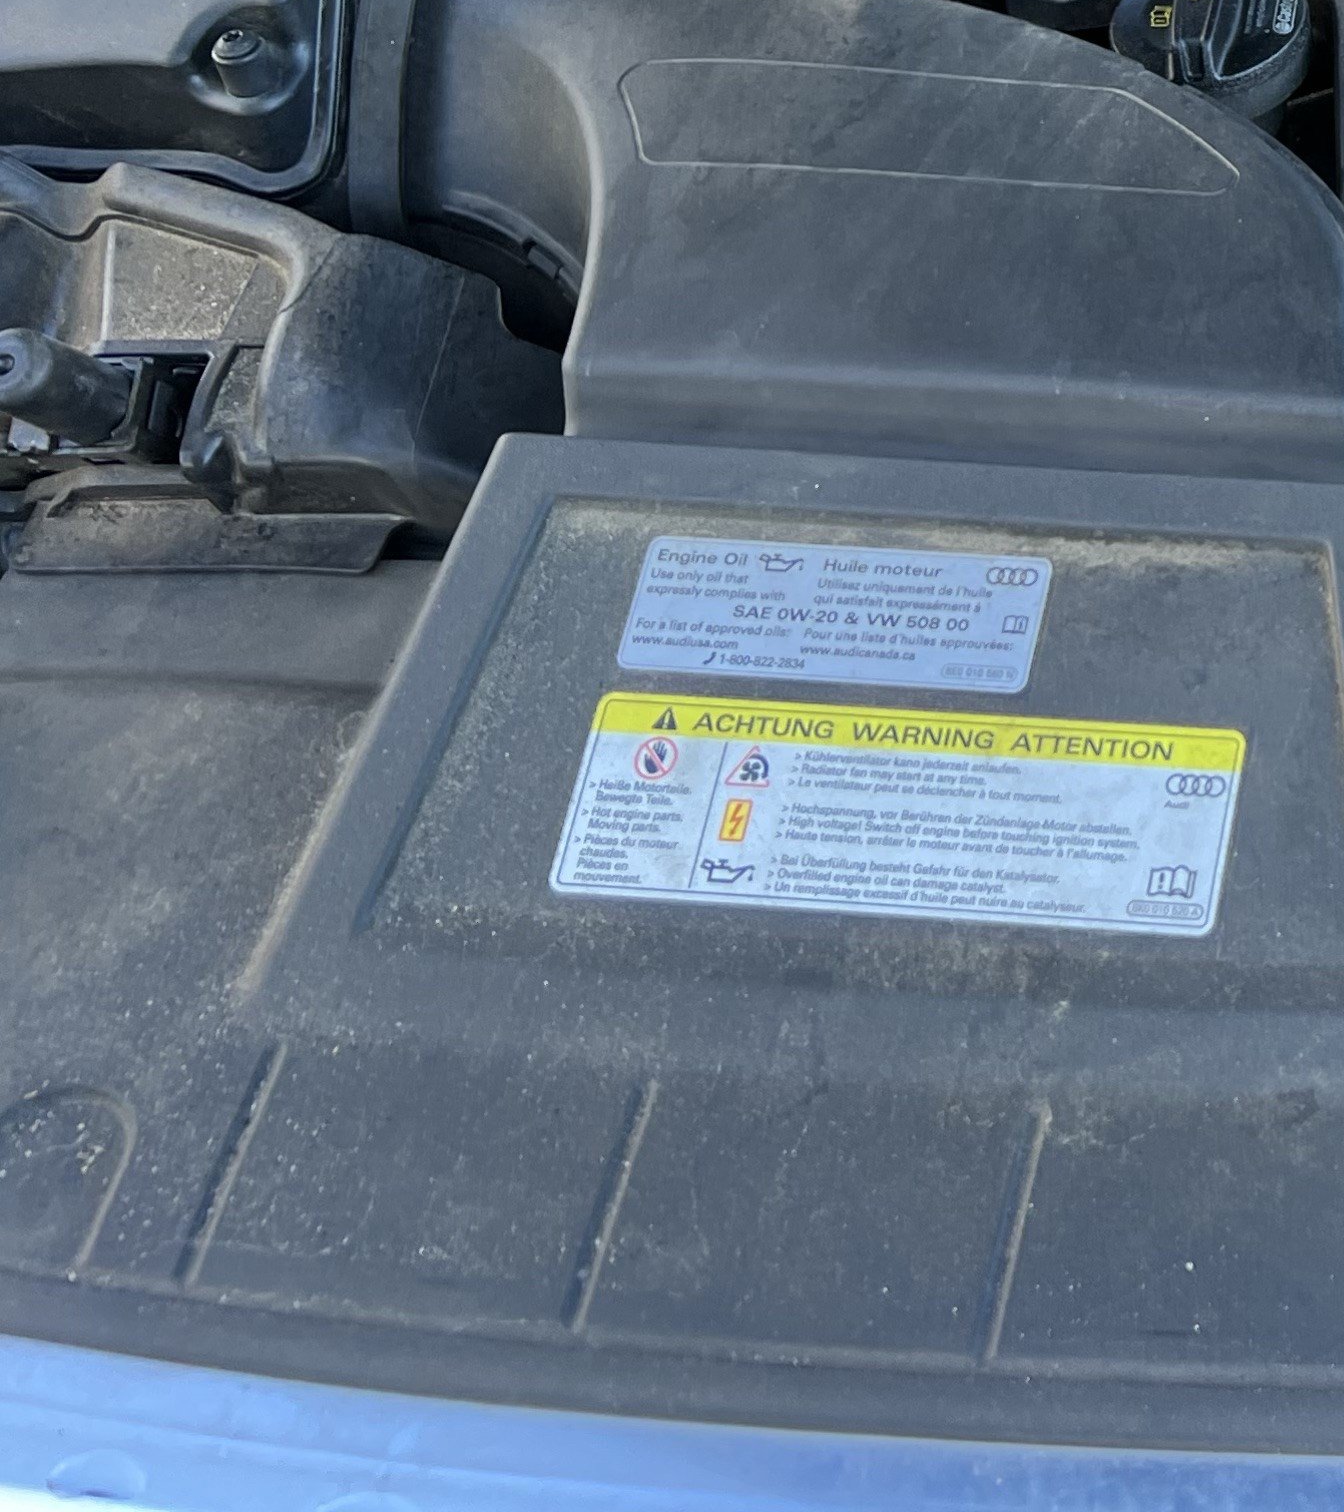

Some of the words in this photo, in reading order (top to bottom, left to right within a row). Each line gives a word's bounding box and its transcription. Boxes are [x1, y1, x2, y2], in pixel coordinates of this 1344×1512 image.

[658, 549, 717, 565] Engine
[724, 552, 748, 566] Oil
[823, 559, 868, 573] Huile
[874, 565, 942, 577] moteur
[651, 568, 674, 580] Use
[677, 570, 702, 584] only
[706, 571, 722, 582] oil
[725, 573, 749, 584] that
[647, 586, 701, 598] expressly
[705, 589, 757, 600] complies
[760, 592, 785, 601] with
[864, 583, 935, 595] uniquement
[938, 585, 953, 596] de
[813, 595, 833, 605] qui
[836, 596, 883, 607] satisfait
[733, 605, 772, 619] SAE
[778, 608, 838, 623] 0W-20
[867, 613, 901, 627] VW
[907, 616, 940, 630] 508
[946, 618, 970, 632] 00
[635, 617, 656, 629] For
[670, 620, 687, 631] list
[690, 621, 704, 632] of
[706, 625, 763, 636] approved
[633, 636, 738, 649] www.audiusa.com
[804, 628, 832, 640] Pour
[835, 633, 857, 642] une
[861, 632, 886, 644] liste
[801, 647, 915, 661] www.audicanada.ca
[695, 714, 833, 739] ACHTUNG
[854, 724, 993, 749] WARNING
[1012, 734, 1172, 759] ATTENTION
[802, 763, 847, 776] Radiator
[850, 767, 868, 778] fan
[870, 770, 894, 781] may
[923, 773, 935, 782] at
[936, 775, 957, 785] any
[797, 776, 812, 787] Le
[901, 786, 914, 794] se
[591, 807, 611, 817] Hot
[613, 810, 650, 821] engine
[880, 811, 898, 820] vor
[954, 813, 973, 825] der
[588, 818, 630, 833] Moving
[788, 816, 815, 829] High
[865, 821, 902, 833] Switch
[904, 824, 921, 835] off
[922, 827, 960, 838] engine
[620, 836, 636, 847] du
[639, 839, 678, 850] moteur
[919, 840, 959, 851] moteur
[995, 844, 1009, 854] de
[614, 863, 629, 871] en
[971, 868, 993, 879] den
[774, 881, 790, 892] Un
[833, 874, 871, 885] engine
[874, 875, 889, 886] oil
[890, 878, 910, 887] can
